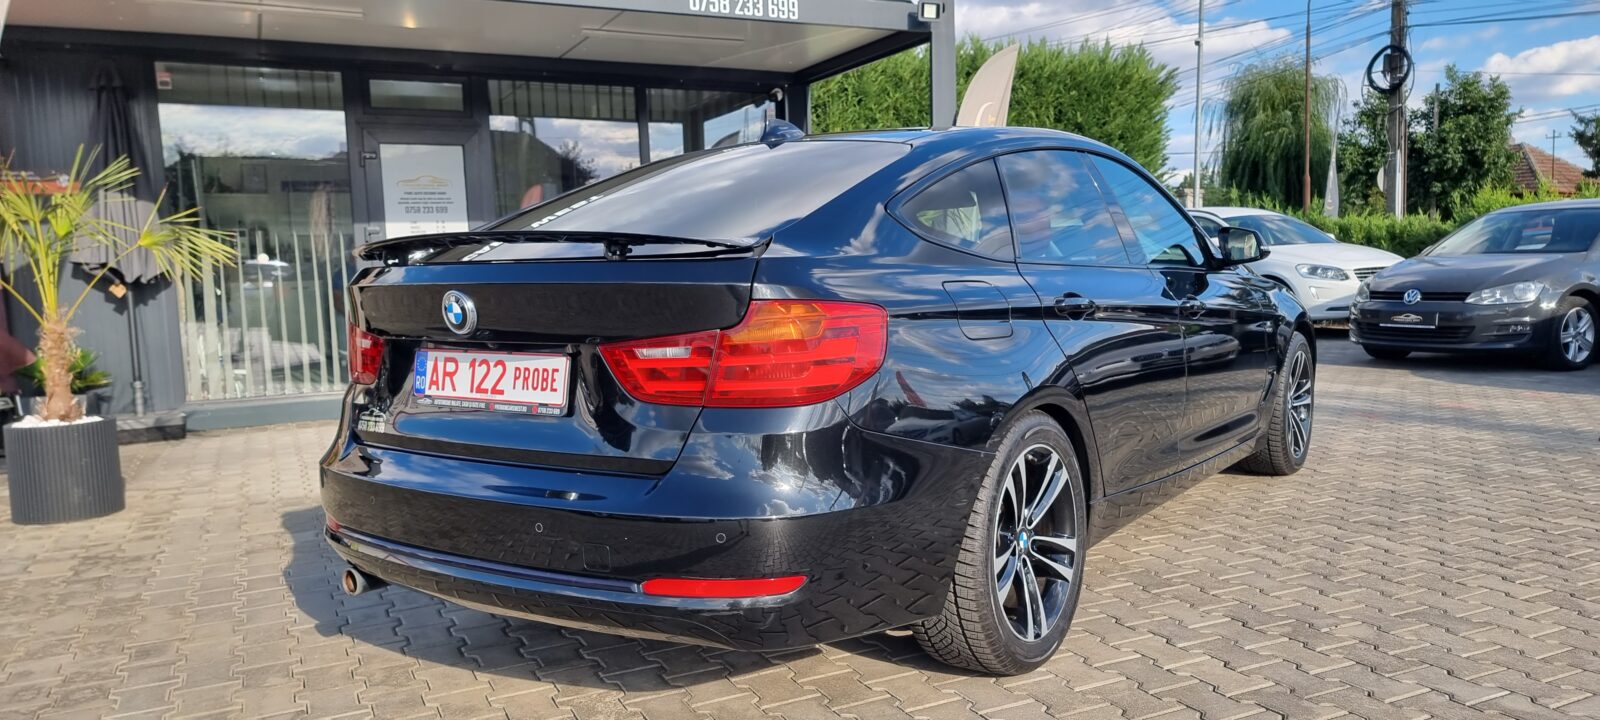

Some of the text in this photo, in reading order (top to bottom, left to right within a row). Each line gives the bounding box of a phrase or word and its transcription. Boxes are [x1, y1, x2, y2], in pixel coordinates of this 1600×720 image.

[689, 0, 799, 20] 0758 233 699
[415, 376, 426, 390] RO
[428, 356, 560, 396] AR 122 PROBE
